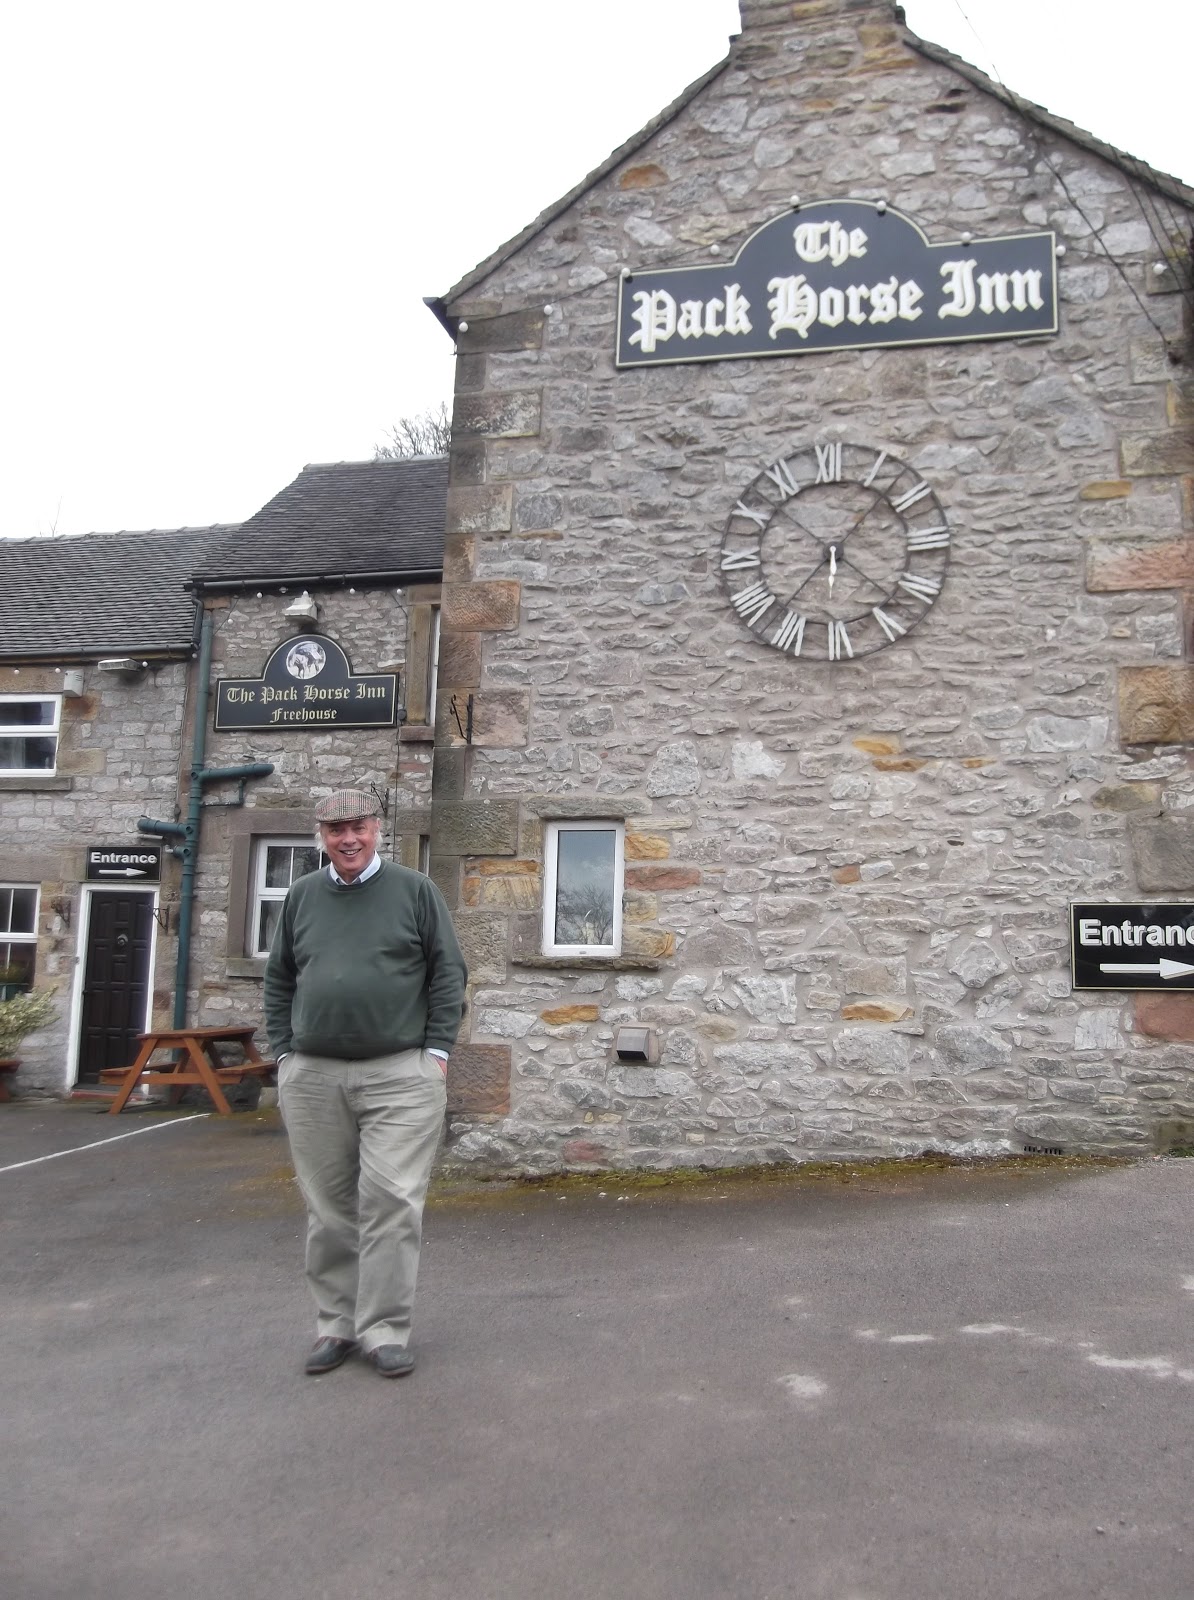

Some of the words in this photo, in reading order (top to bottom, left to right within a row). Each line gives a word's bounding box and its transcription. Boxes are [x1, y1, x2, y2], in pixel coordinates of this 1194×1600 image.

[793, 219, 869, 267] The
[628, 282, 753, 353] Pack
[766, 273, 925, 340] Horse
[937, 258, 1043, 320] Inn
[226, 686, 255, 704] The
[260, 685, 298, 705] Pack
[303, 684, 351, 703] Horse
[355, 682, 386, 699] Inn
[269, 706, 338, 724] Freehouse
[90, 851, 158, 864] Entrance
